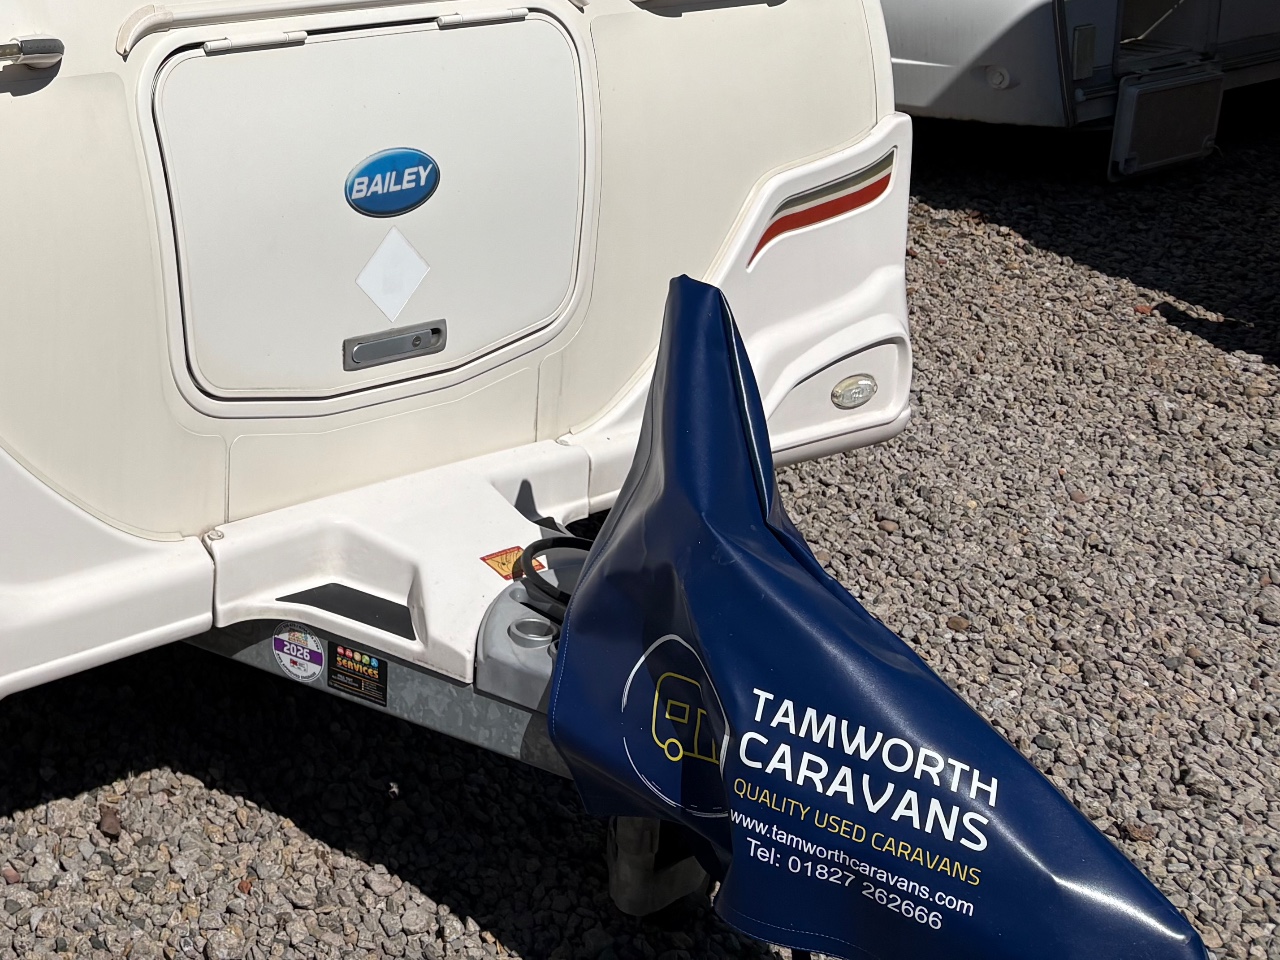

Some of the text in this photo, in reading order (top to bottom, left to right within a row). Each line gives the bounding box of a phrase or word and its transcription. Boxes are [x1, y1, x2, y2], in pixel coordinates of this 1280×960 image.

[351, 164, 433, 200] BAILEY
[283, 641, 311, 661] 2026
[336, 656, 379, 679] SERVICES
[739, 731, 989, 852] CARAVANS
[753, 688, 998, 807] TAMWORTH
[730, 809, 974, 916] www.tamworthcaravans.com
[733, 778, 982, 886] QUALITY USED CARAVANS
[747, 837, 943, 930] Tel: 01827 262666
